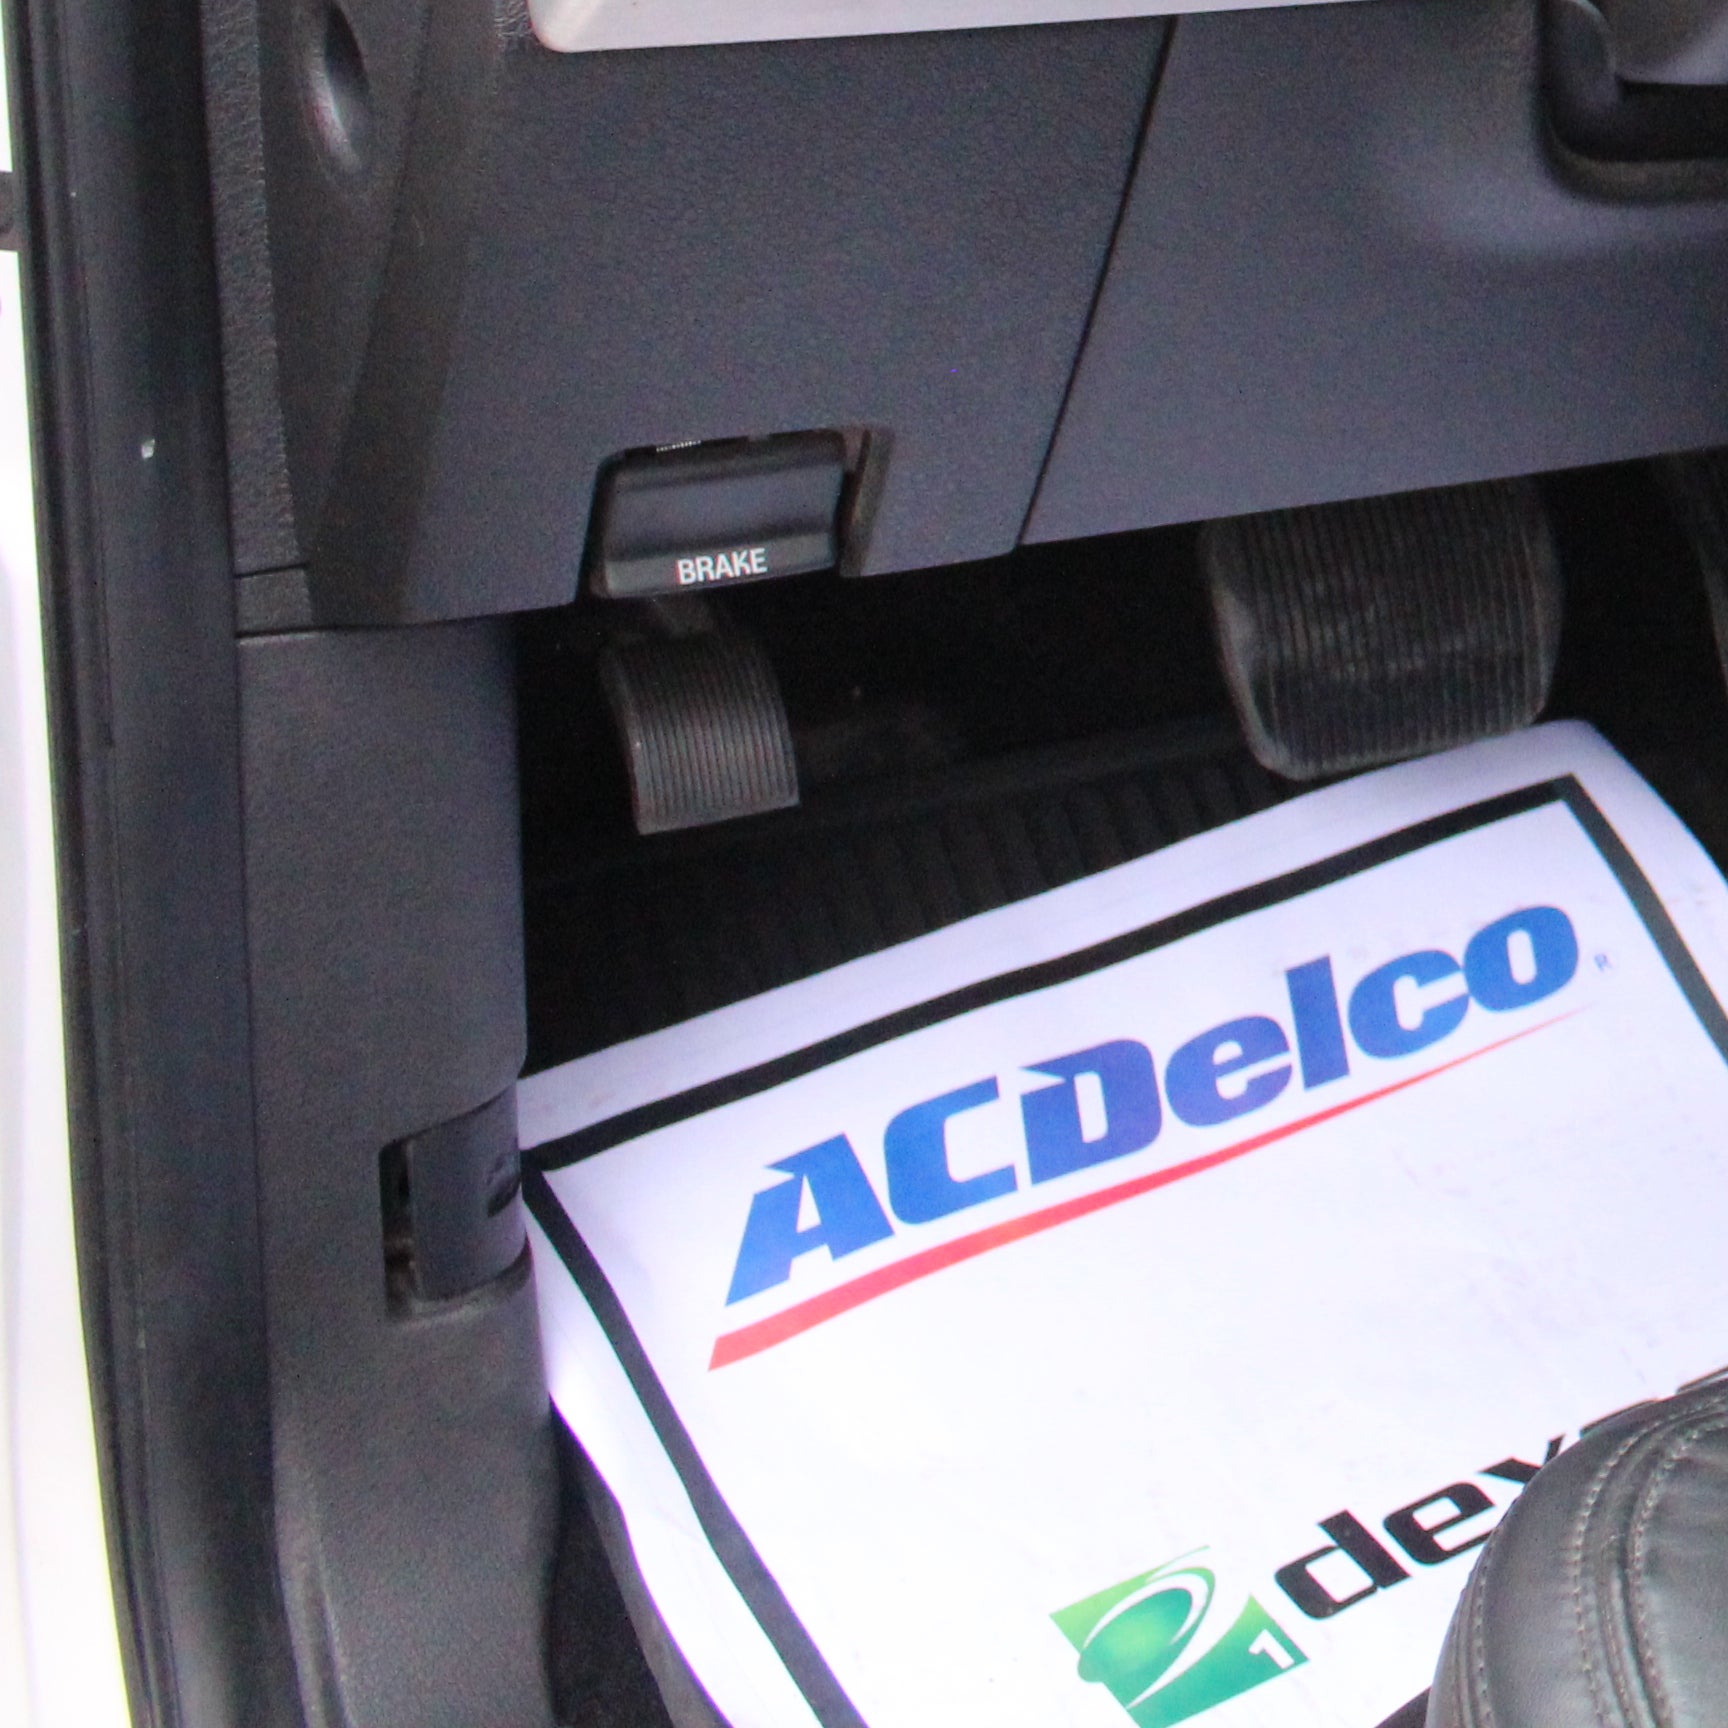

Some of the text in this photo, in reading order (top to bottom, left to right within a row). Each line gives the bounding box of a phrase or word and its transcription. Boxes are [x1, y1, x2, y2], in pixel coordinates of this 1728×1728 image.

[675, 547, 768, 585] BRAKE
[725, 904, 1579, 1307] ACDelco
[1248, 1628, 1295, 1670] 1
